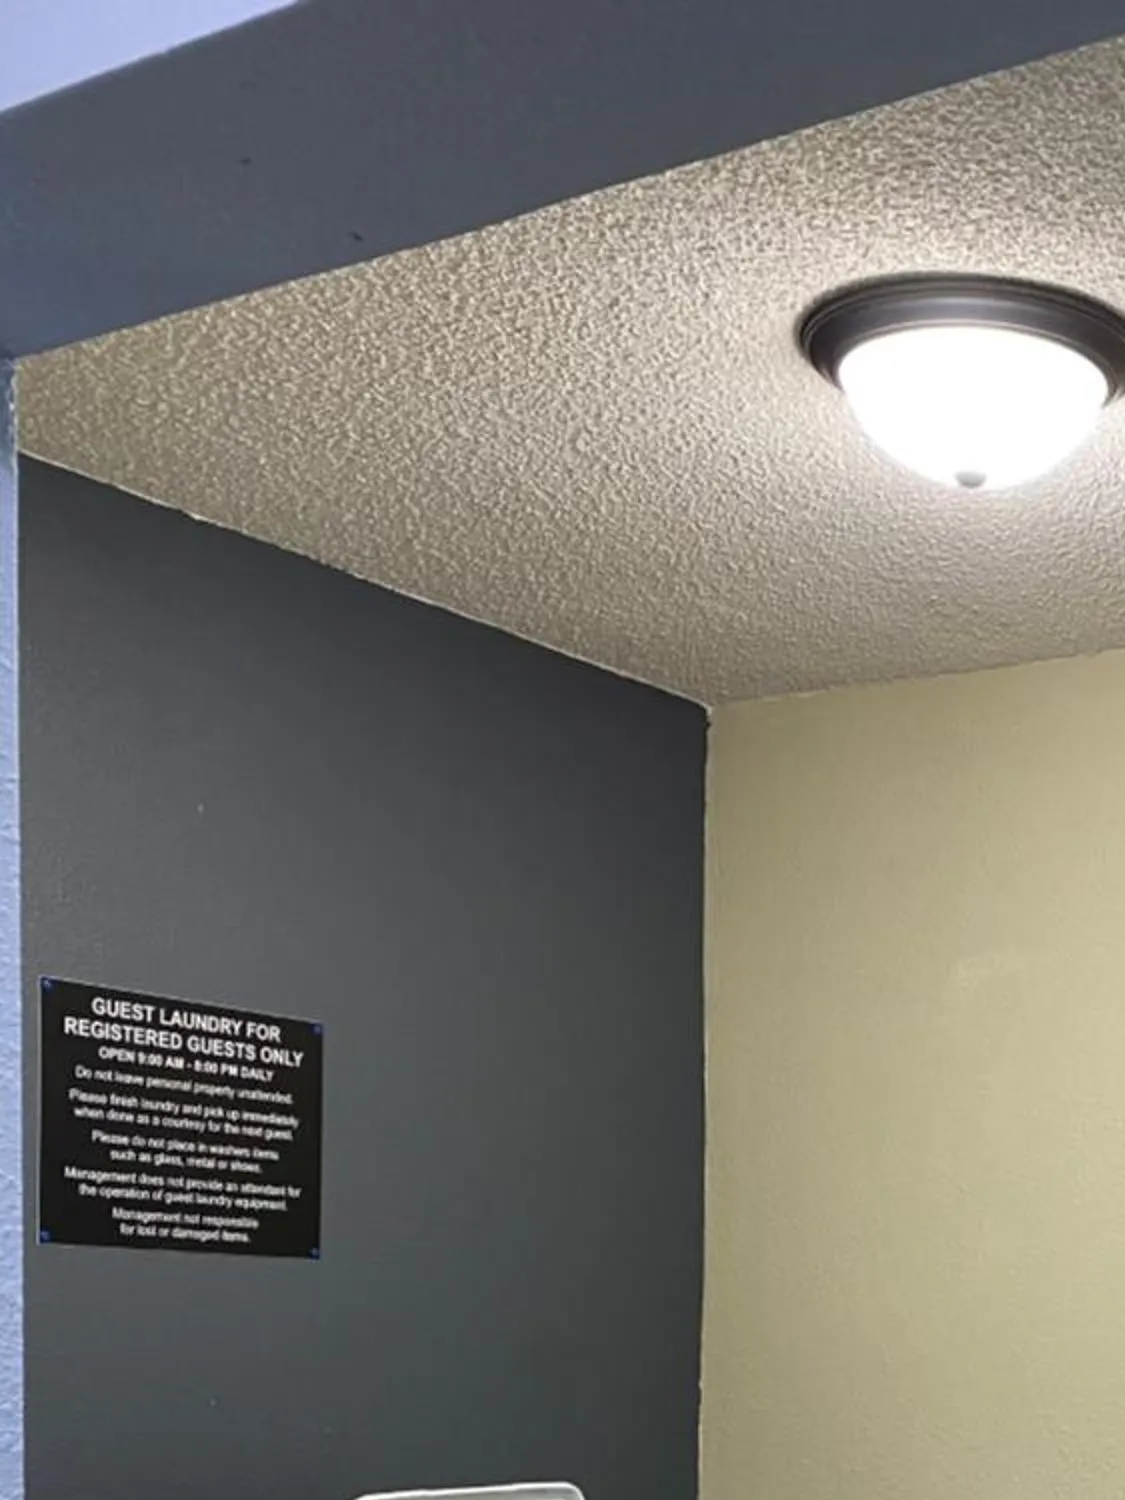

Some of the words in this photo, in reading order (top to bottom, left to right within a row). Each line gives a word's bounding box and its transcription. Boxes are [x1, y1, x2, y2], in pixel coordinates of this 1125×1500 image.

[91, 997, 155, 1022] GUEST
[159, 1008, 243, 1036] LAUNDRY
[246, 1021, 281, 1042] FOR
[64, 1016, 183, 1049] REGISTERED
[187, 1034, 257, 1060] GUESTS
[260, 1045, 304, 1067] ONLY
[98, 1046, 135, 1062] OPEN
[165, 1056, 185, 1069] AM
[220, 1062, 238, 1076] PM
[240, 1065, 274, 1082] DAILY
[75, 1065, 92, 1079] Do
[94, 1070, 112, 1082] not
[115, 1072, 144, 1086] leave
[146, 1077, 192, 1092] personal
[193, 1082, 235, 1100] property
[69, 1088, 108, 1105] Please
[140, 1098, 179, 1115] laundry
[182, 1104, 202, 1117] and
[204, 1106, 224, 1119] pick
[226, 1110, 240, 1121] up
[241, 1111, 299, 1129] immediately
[74, 1107, 104, 1120] when
[106, 1109, 134, 1123] done
[136, 1113, 150, 1125] as
[162, 1116, 206, 1133] courtesy
[208, 1119, 221, 1132] for
[224, 1122, 240, 1135] the
[241, 1125, 263, 1137] next
[92, 1129, 129, 1146] Please
[131, 1135, 146, 1147] do
[148, 1138, 165, 1149] not
[167, 1140, 196, 1154] place
[209, 1145, 250, 1158] washers
[110, 1149, 136, 1162] such
[138, 1152, 152, 1163] as
[186, 1157, 216, 1169] metal
[217, 1160, 228, 1170] or
[64, 1166, 137, 1184] Management
[138, 1172, 164, 1186] does
[166, 1176, 184, 1188] not
[186, 1178, 223, 1192] provide
[225, 1182, 239, 1193] an
[287, 1185, 302, 1198] for
[78, 1183, 97, 1196] the
[98, 1186, 150, 1200] operation
[152, 1189, 163, 1201] of
[164, 1191, 194, 1204] guest
[195, 1192, 232, 1209] laundry
[112, 1206, 182, 1224] Management
[183, 1213, 201, 1225] not
[202, 1215, 259, 1231] responsible
[119, 1222, 134, 1236] for
[136, 1225, 156, 1237] lost
[158, 1227, 169, 1237] or
[171, 1228, 220, 1243] damaged
